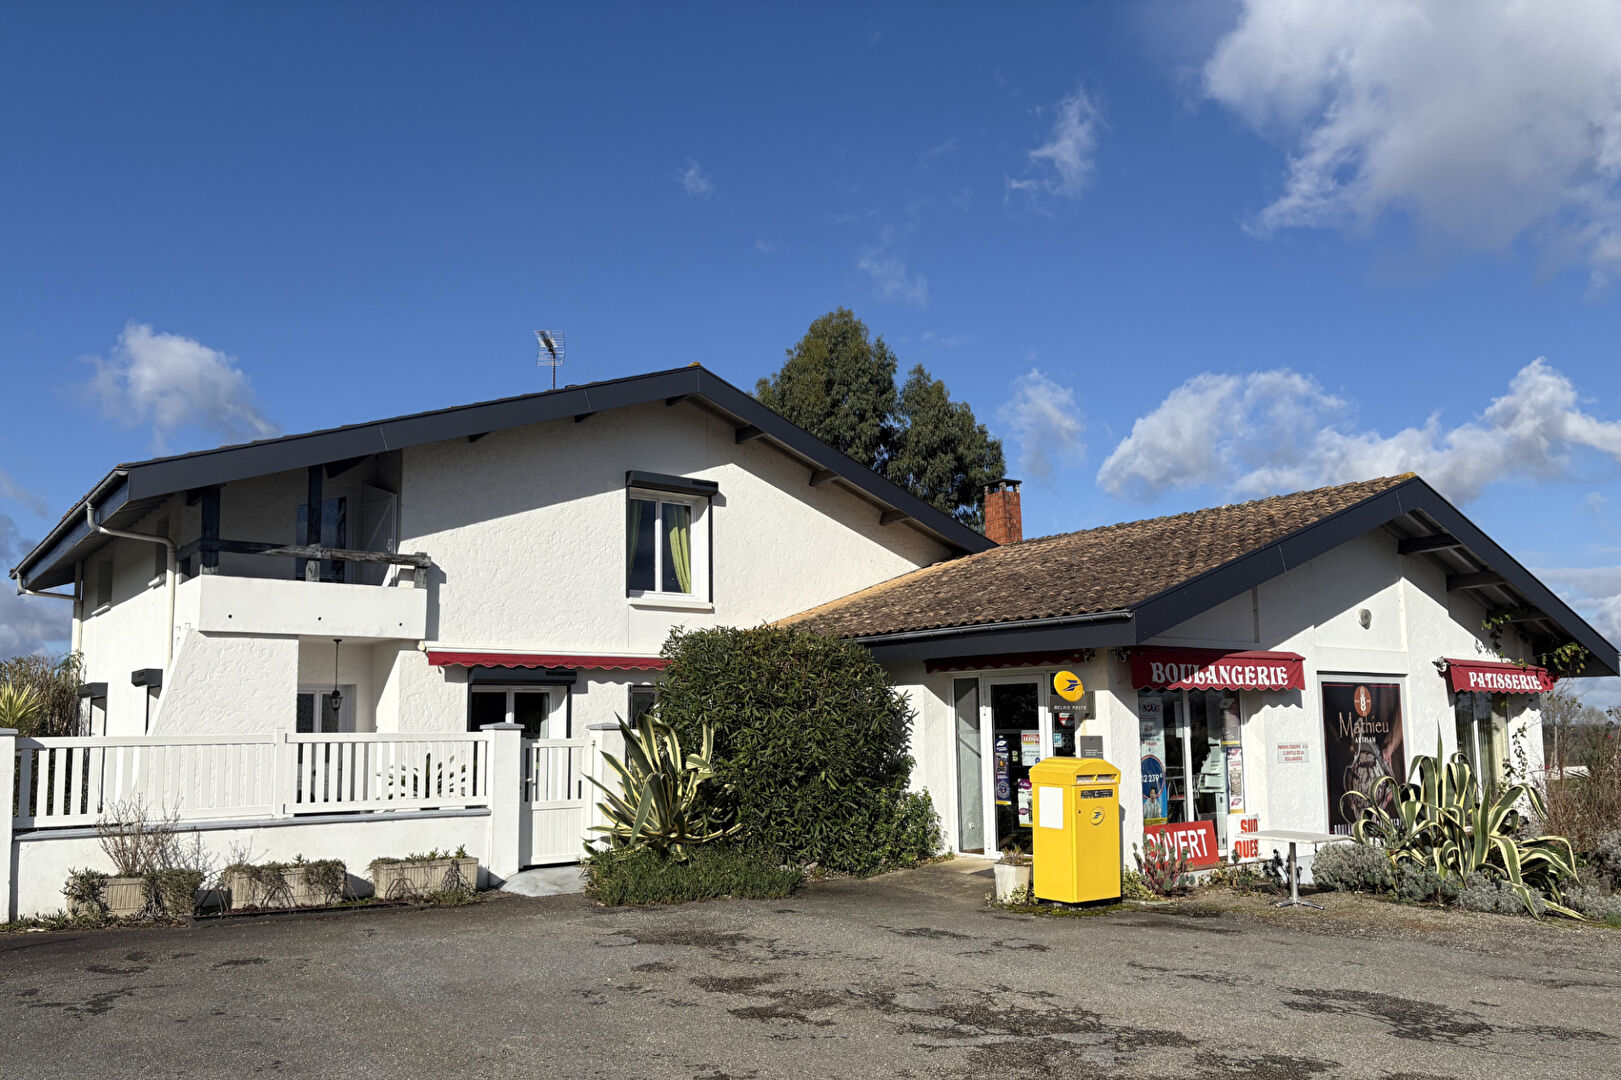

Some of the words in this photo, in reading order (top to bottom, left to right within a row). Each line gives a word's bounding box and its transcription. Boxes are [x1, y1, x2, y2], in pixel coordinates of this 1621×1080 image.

[1151, 662, 1289, 686] BOULANGERIE
[1468, 671, 1543, 691] PATISSERIE
[1339, 711, 1390, 739] Mathieu
[1355, 736, 1377, 744] ARTISAN
[1146, 828, 1208, 863] OUVERT
